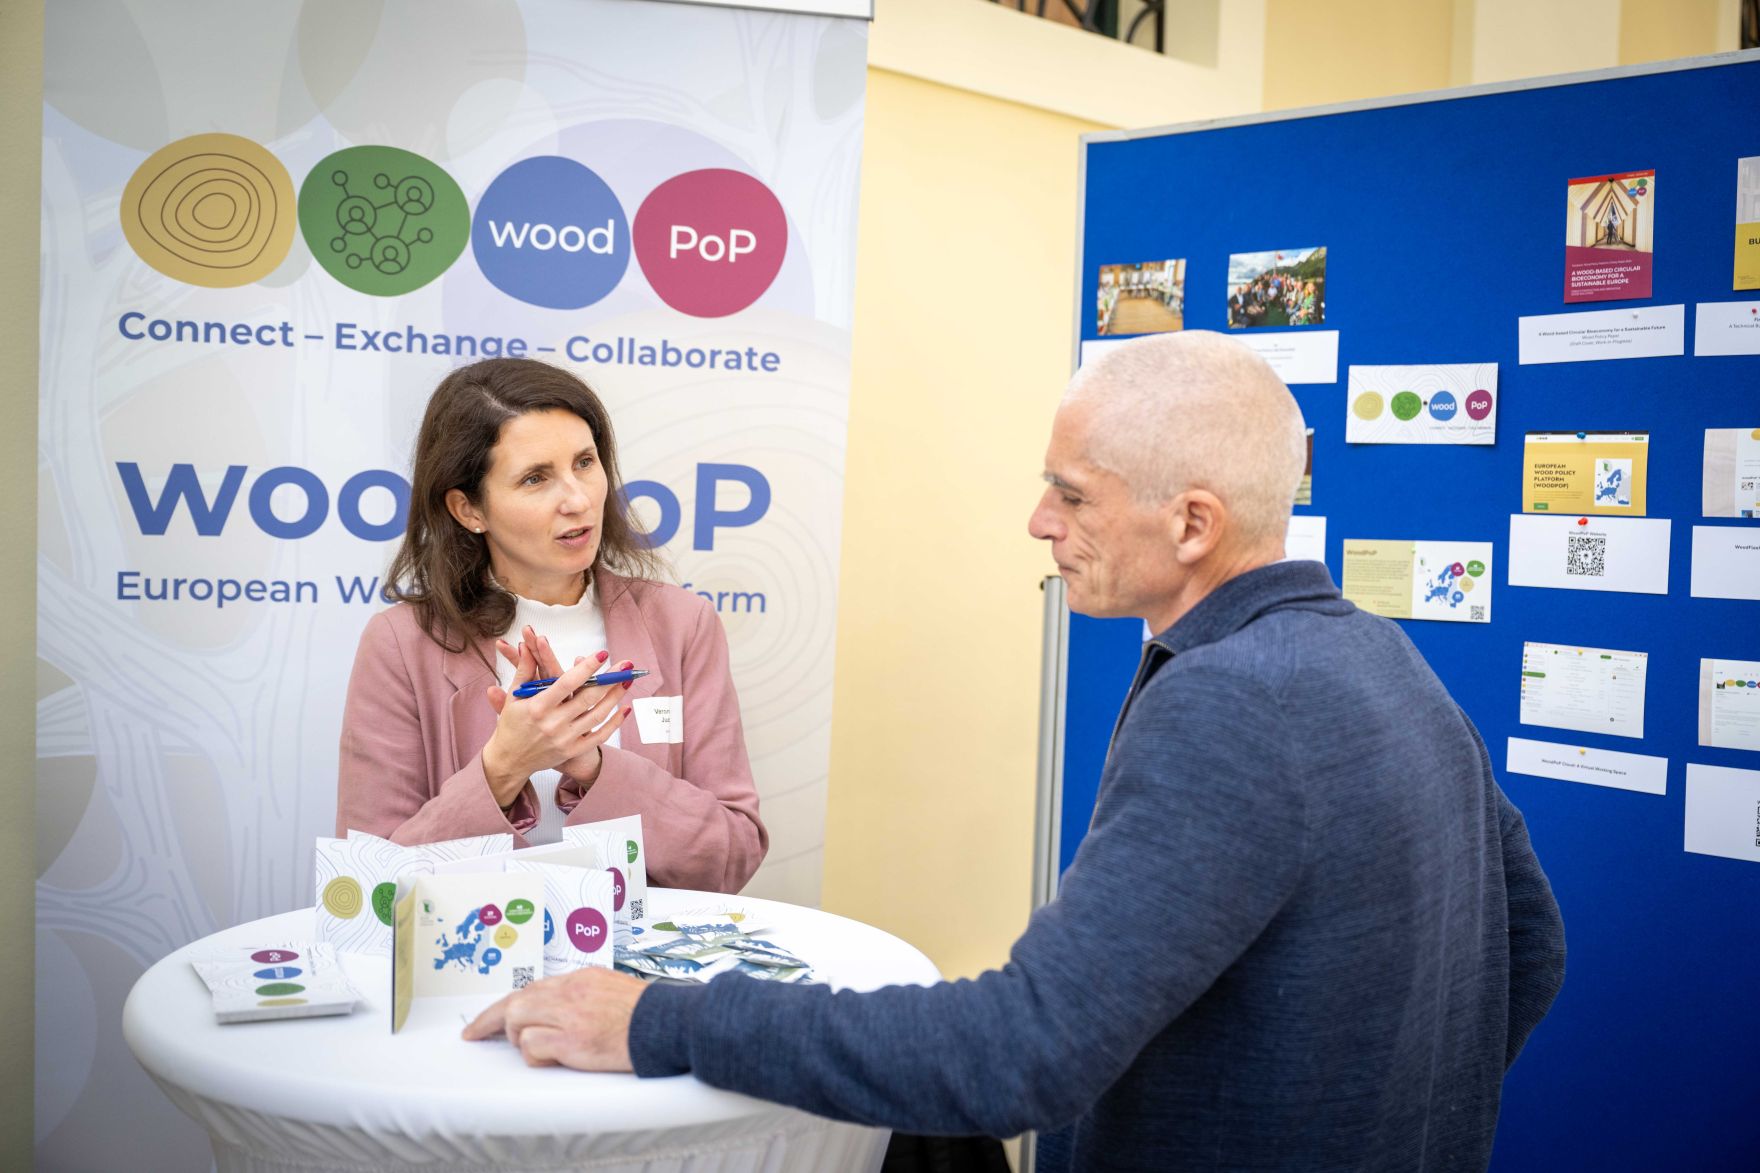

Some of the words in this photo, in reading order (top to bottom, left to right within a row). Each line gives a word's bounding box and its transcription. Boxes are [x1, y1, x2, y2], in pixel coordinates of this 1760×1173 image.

[488, 219, 615, 255] wood
[669, 224, 757, 263] PoP
[118, 311, 295, 348] Connect
[335, 322, 528, 360] Exchange
[565, 335, 781, 373] Collaborate
[1431, 401, 1455, 411] wood
[1471, 400, 1488, 410] PoP
[117, 571, 319, 609] European
[575, 922, 601, 938] PoP
